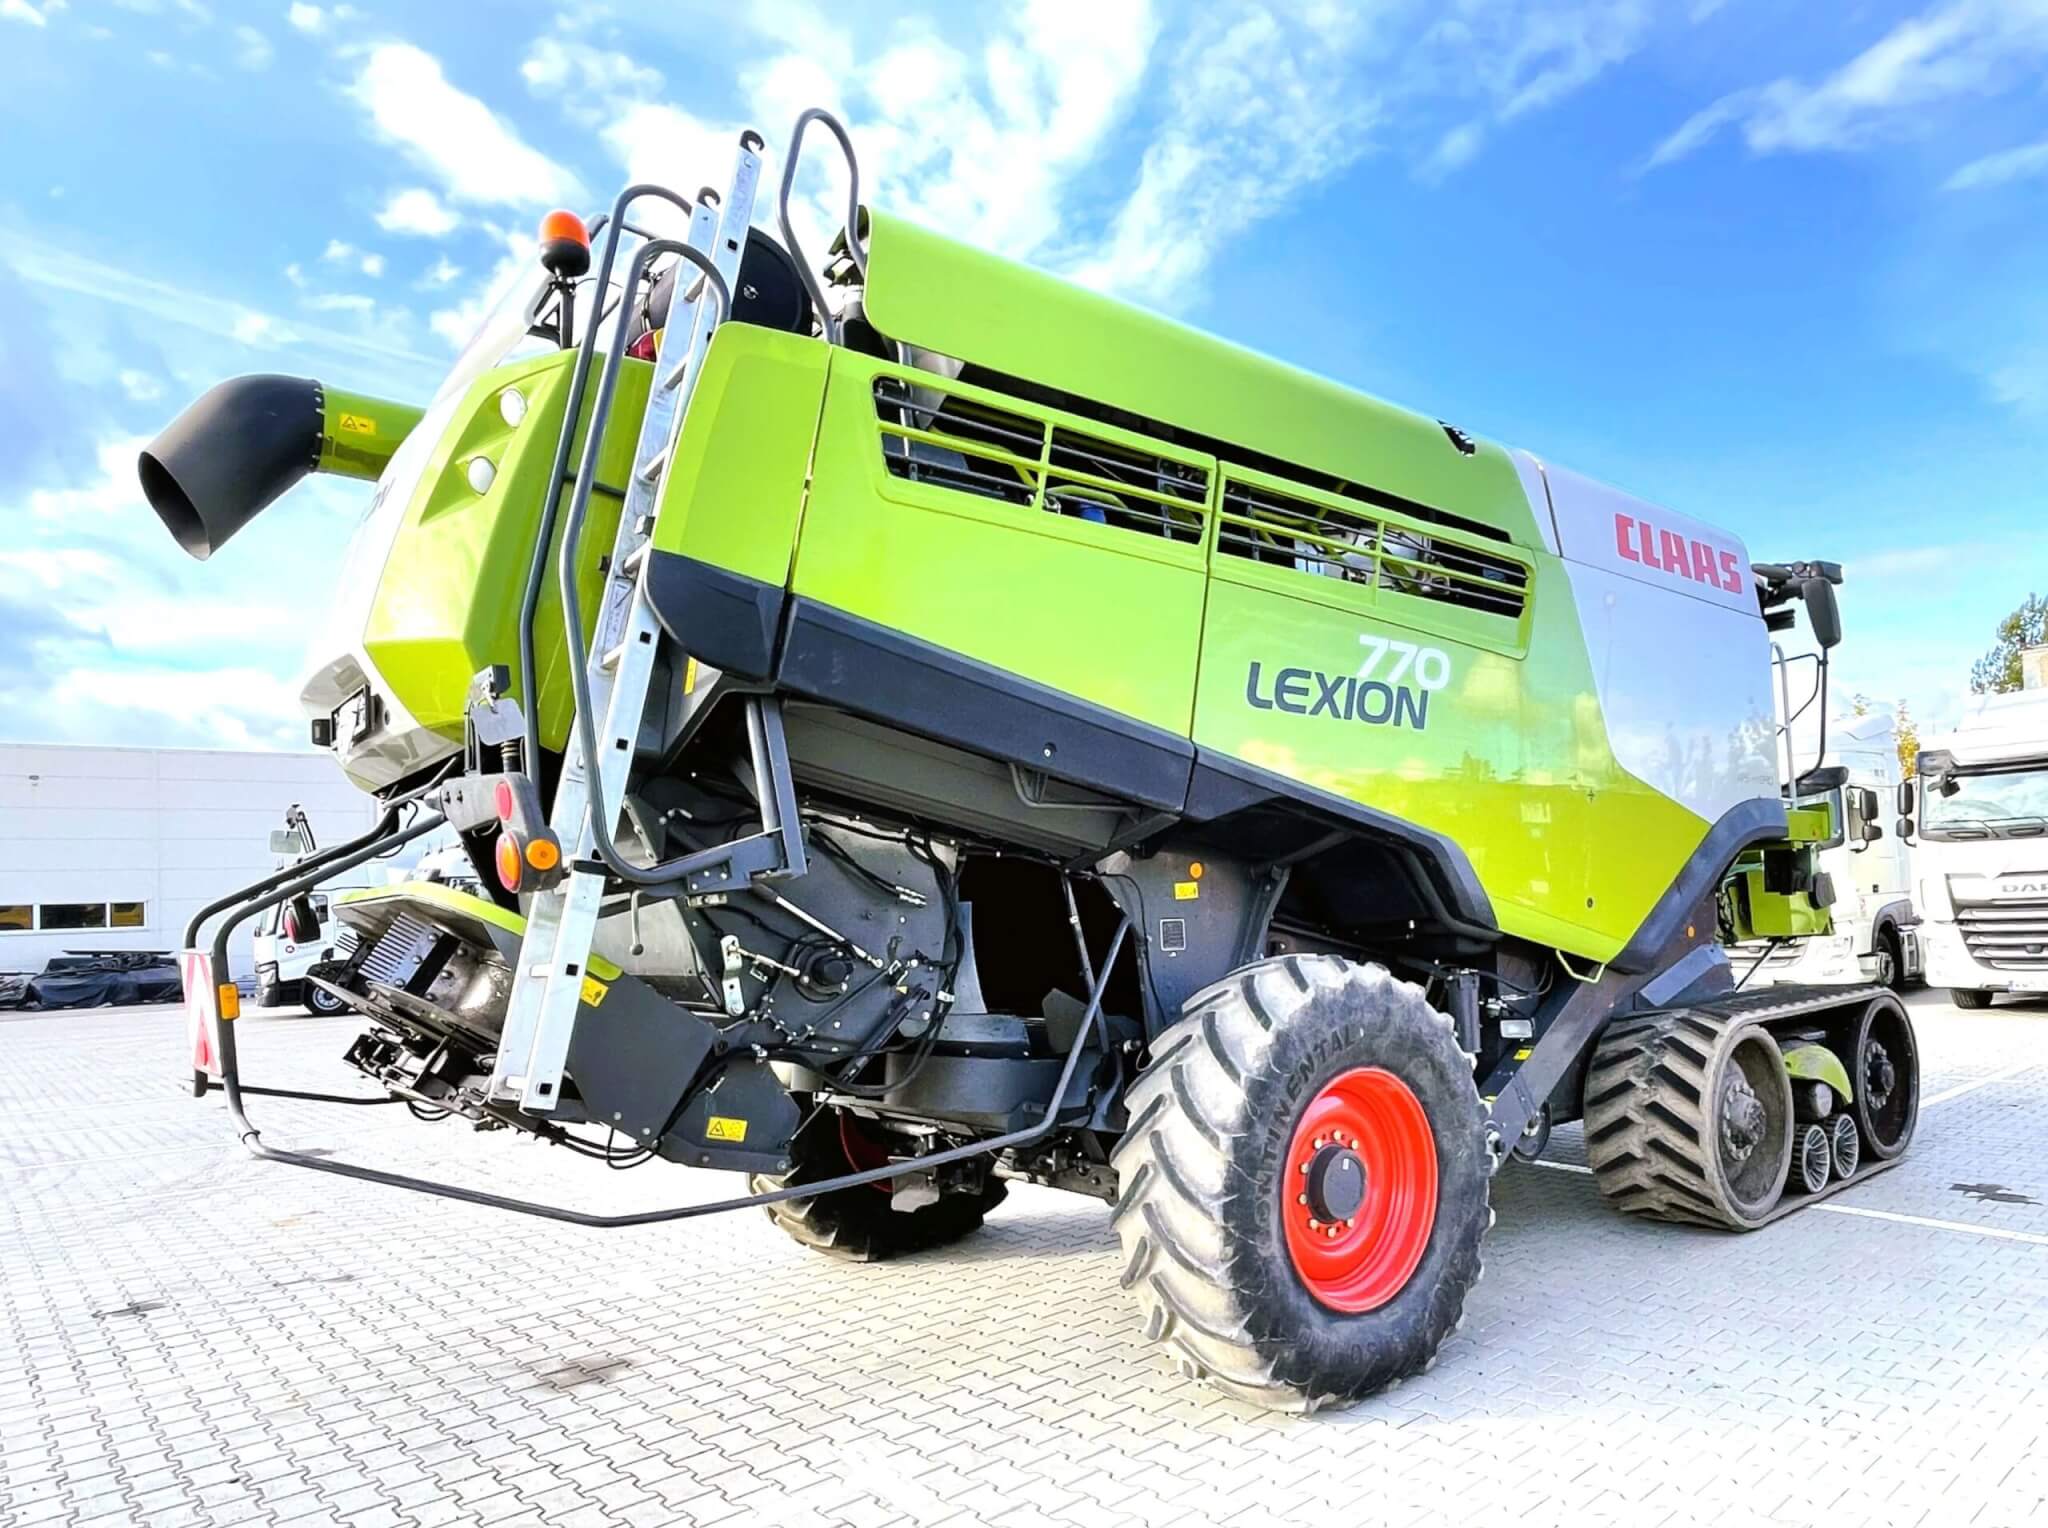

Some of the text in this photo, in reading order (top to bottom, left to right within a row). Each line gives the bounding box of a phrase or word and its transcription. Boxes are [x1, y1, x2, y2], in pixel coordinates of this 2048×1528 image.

[1615, 512, 1743, 594] CLAAS
[1246, 662, 1428, 730] LEXION
[1357, 635, 1451, 690] 770
